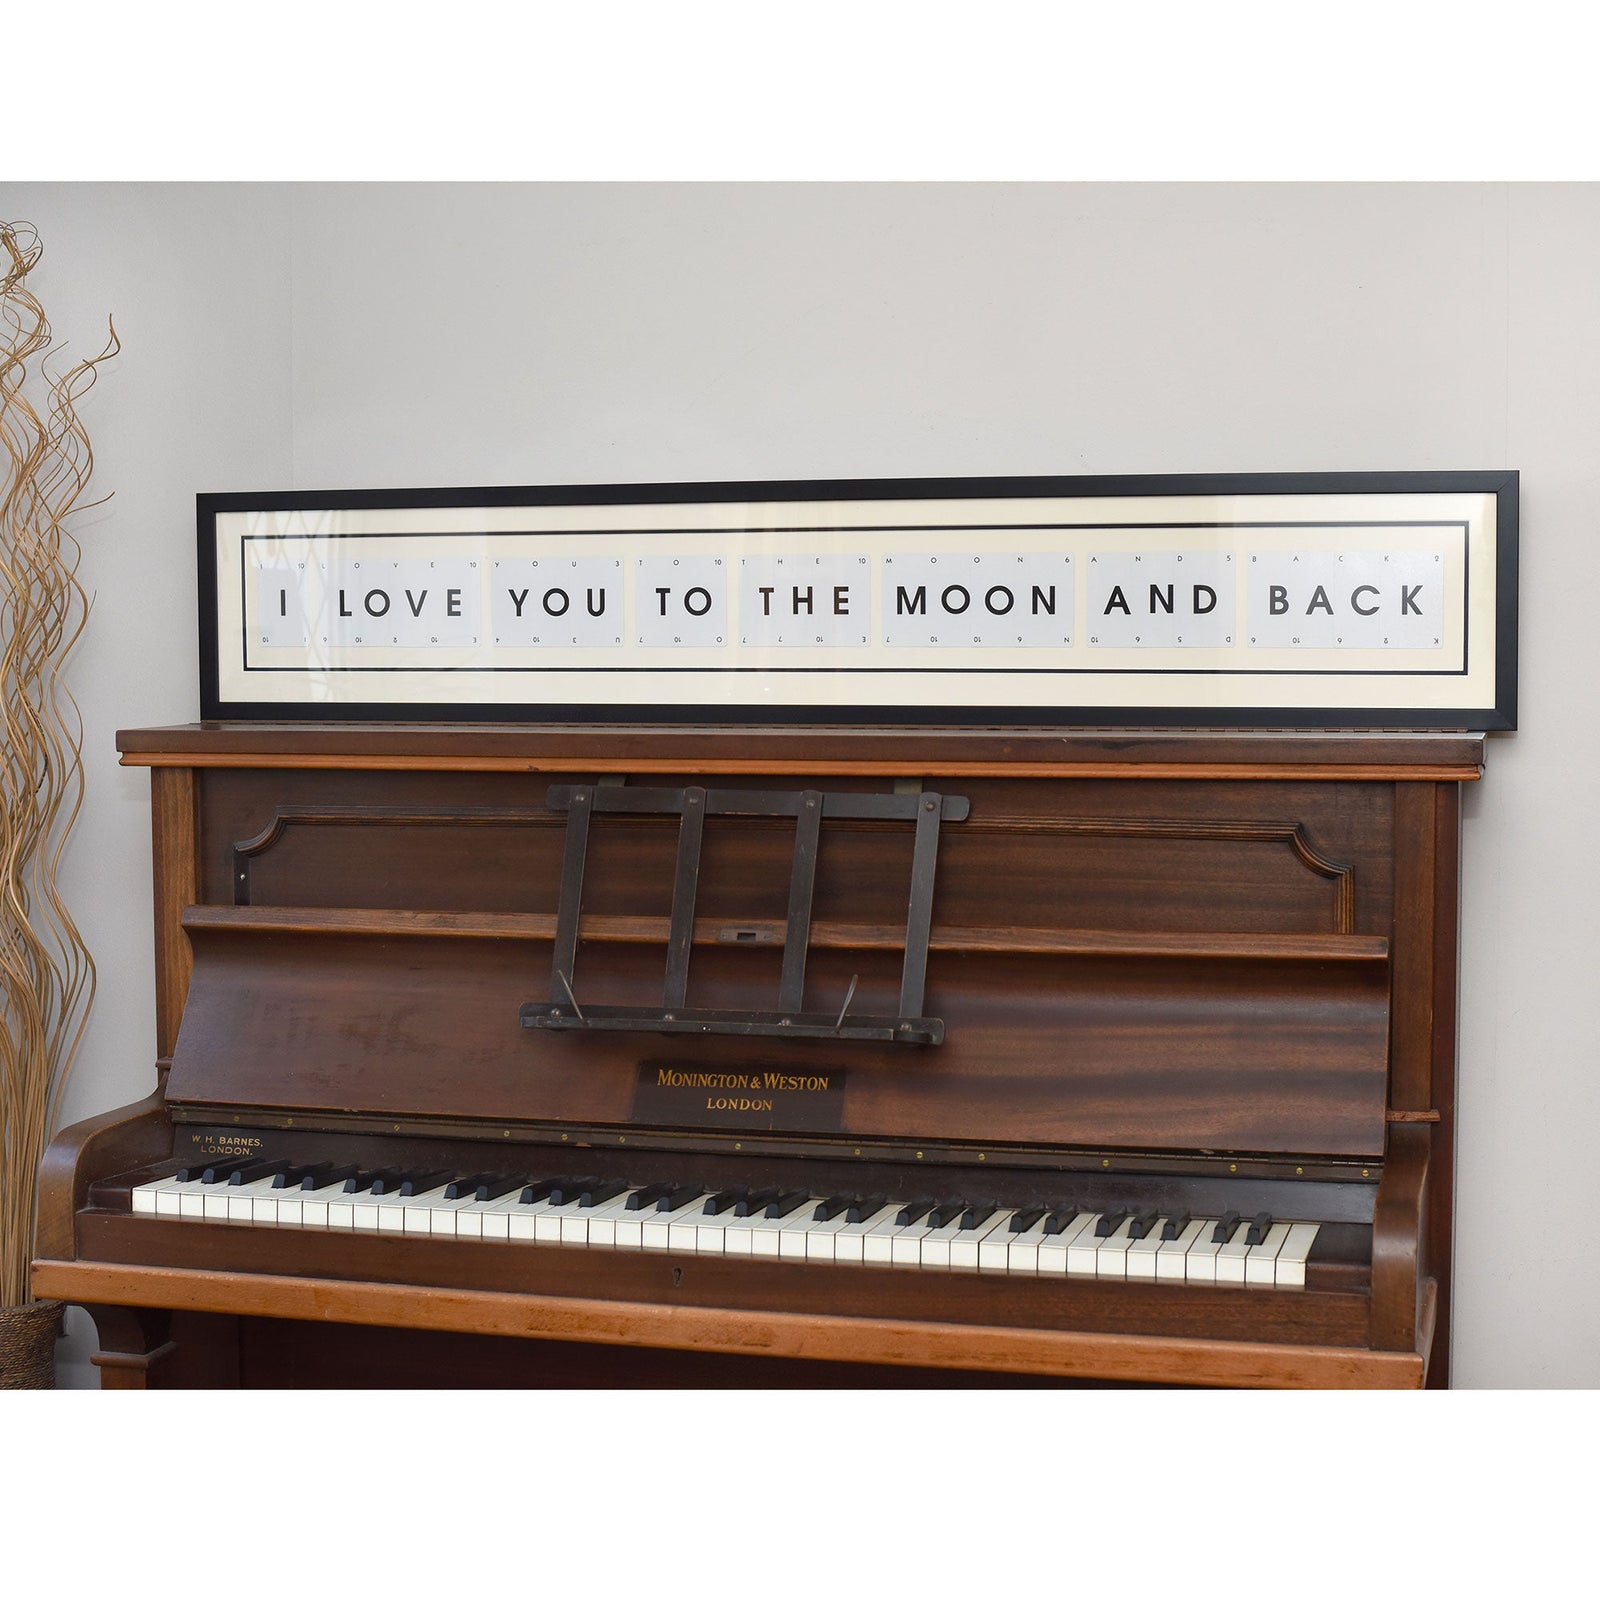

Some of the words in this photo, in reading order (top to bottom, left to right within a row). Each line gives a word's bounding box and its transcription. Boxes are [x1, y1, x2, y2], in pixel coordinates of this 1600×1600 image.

[280, 589, 287, 617] I
[338, 588, 462, 618] LOVE
[507, 587, 606, 618] YOU
[655, 586, 713, 617] TO
[758, 585, 850, 616] THE
[896, 584, 1056, 616] MOON
[1103, 583, 1218, 616] AND
[1269, 584, 1424, 616] BACK
[750, 1076, 761, 1089] &
[763, 1072, 829, 1091] WESTON
[706, 1097, 773, 1111] LONDON
[201, 1145, 253, 1156] LONDON.
